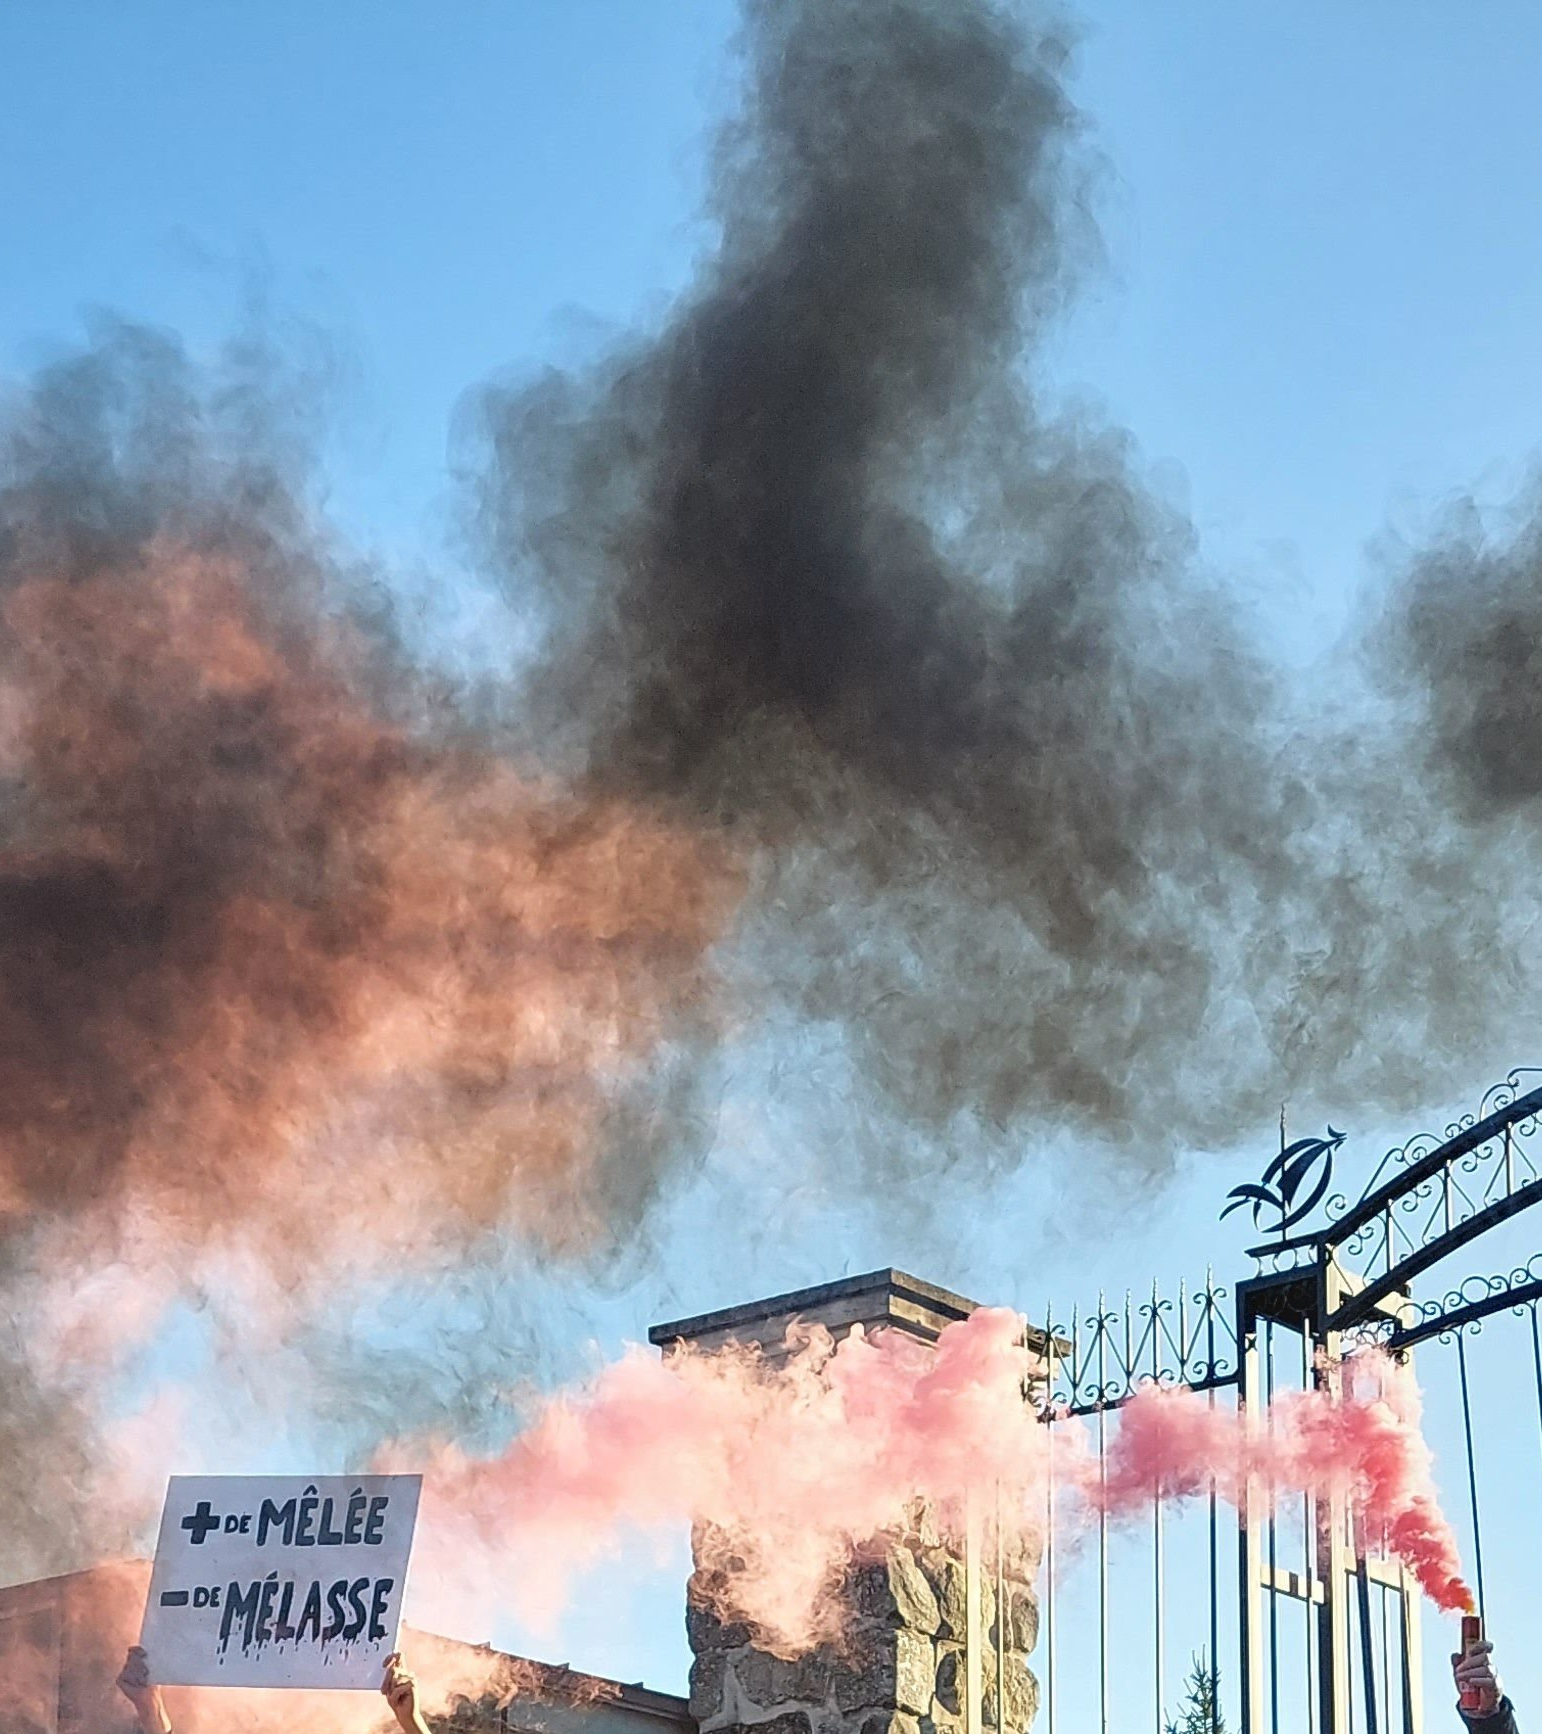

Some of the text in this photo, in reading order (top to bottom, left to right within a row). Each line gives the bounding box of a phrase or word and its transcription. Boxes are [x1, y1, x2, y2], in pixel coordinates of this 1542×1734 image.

[224, 1513, 252, 1535] DE
[256, 1485, 389, 1547] MÊLÉE
[193, 1586, 221, 1607] DE
[219, 1570, 394, 1654] MÉLASSE
